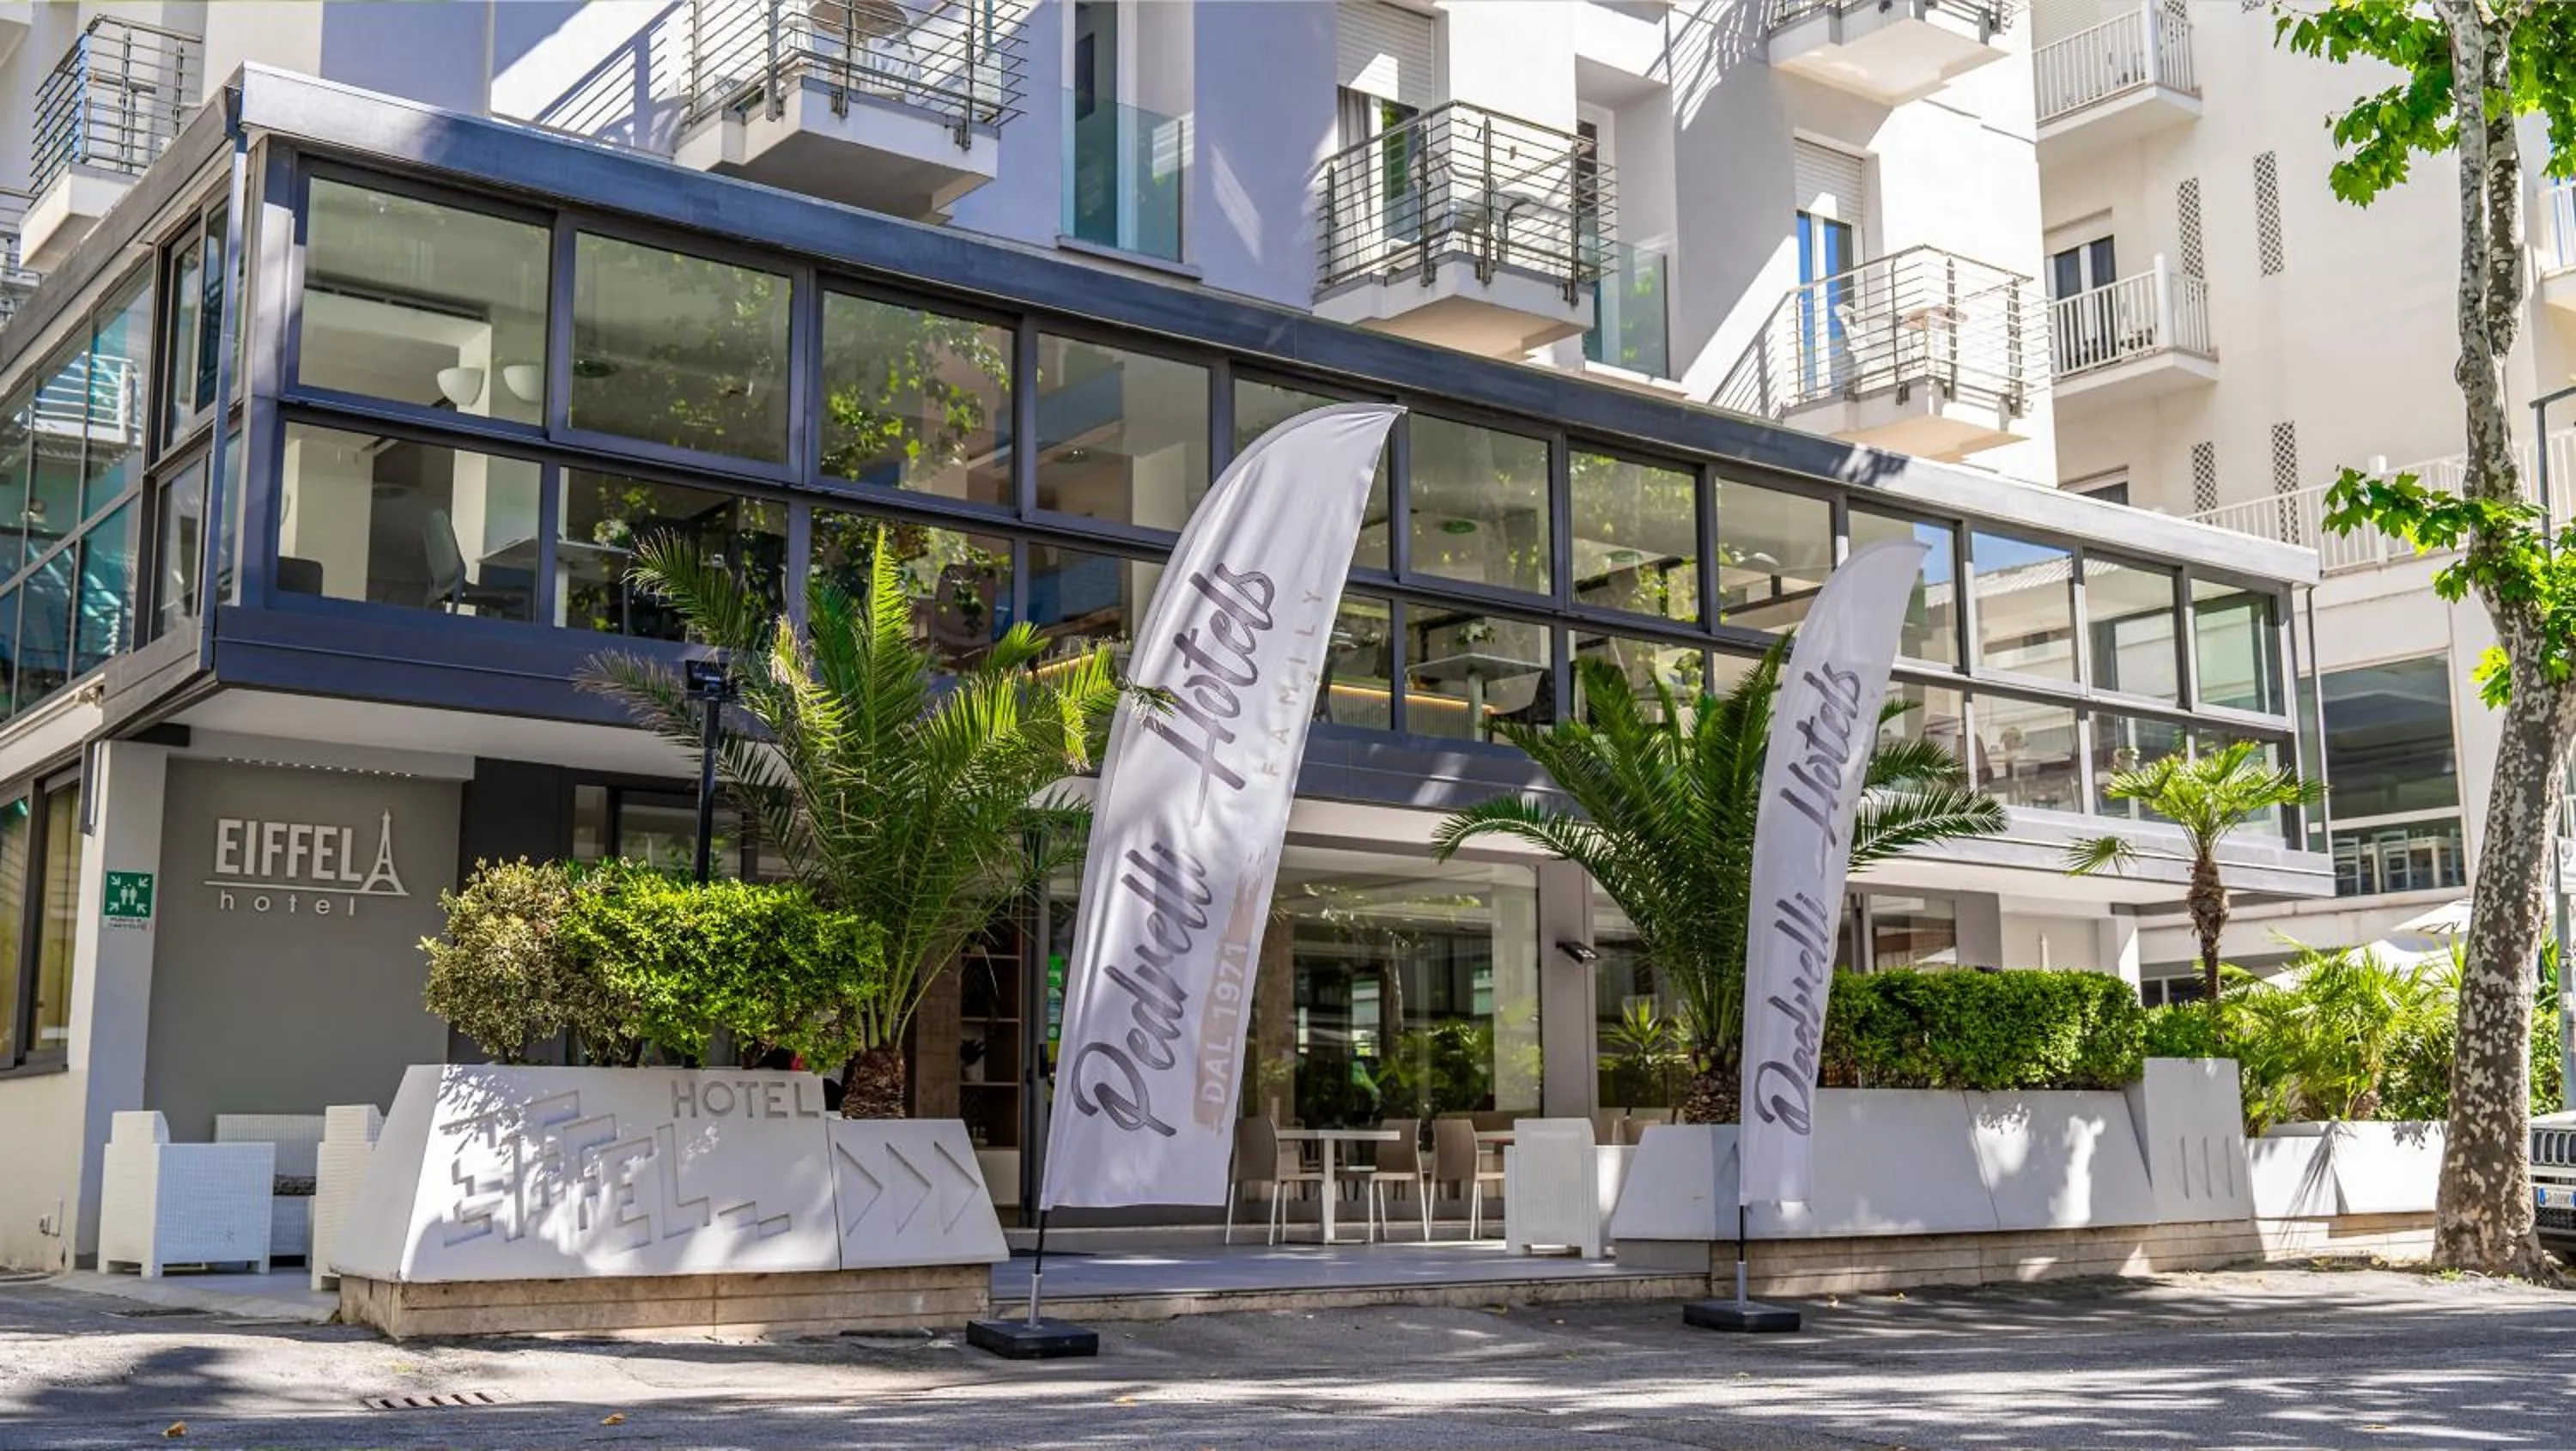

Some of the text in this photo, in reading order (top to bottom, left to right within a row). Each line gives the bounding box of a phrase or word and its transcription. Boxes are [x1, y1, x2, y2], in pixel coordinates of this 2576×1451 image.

[1144, 562, 1276, 827] Hotels
[1262, 589, 1324, 780] FAMILY
[215, 818, 362, 882] EIFFEL
[1779, 662, 1861, 879] Hotels
[220, 890, 355, 916] hotel
[671, 1079, 819, 1119] HOTEL
[1204, 944, 1250, 1106] DAL 1971
